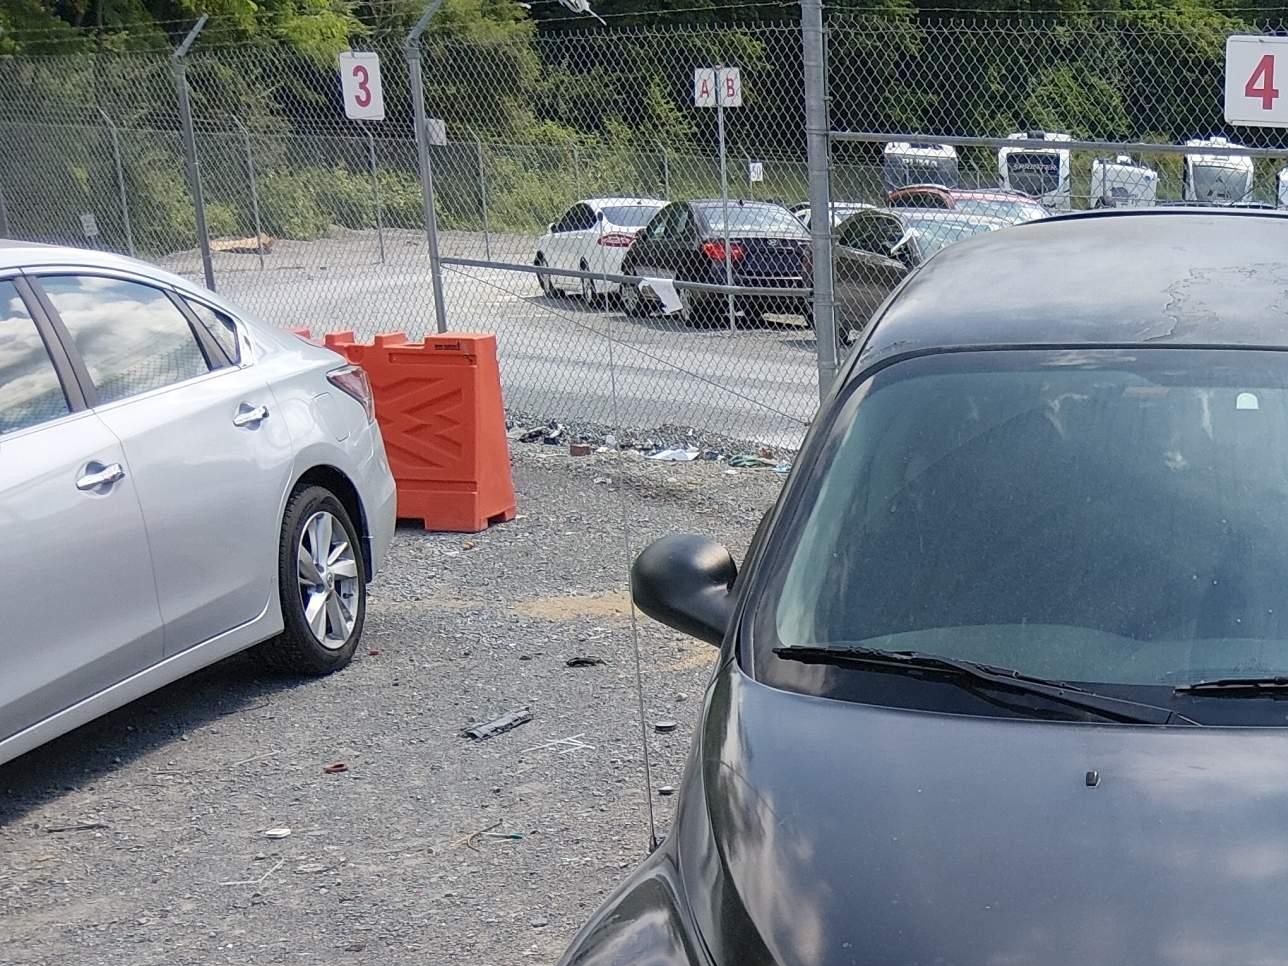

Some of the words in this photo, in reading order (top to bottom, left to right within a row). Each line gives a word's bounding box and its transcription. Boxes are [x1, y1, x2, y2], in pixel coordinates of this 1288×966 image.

[352, 65, 372, 108] 3
[701, 79, 710, 98] A
[726, 77, 736, 98] B
[1244, 54, 1280, 110] 4
